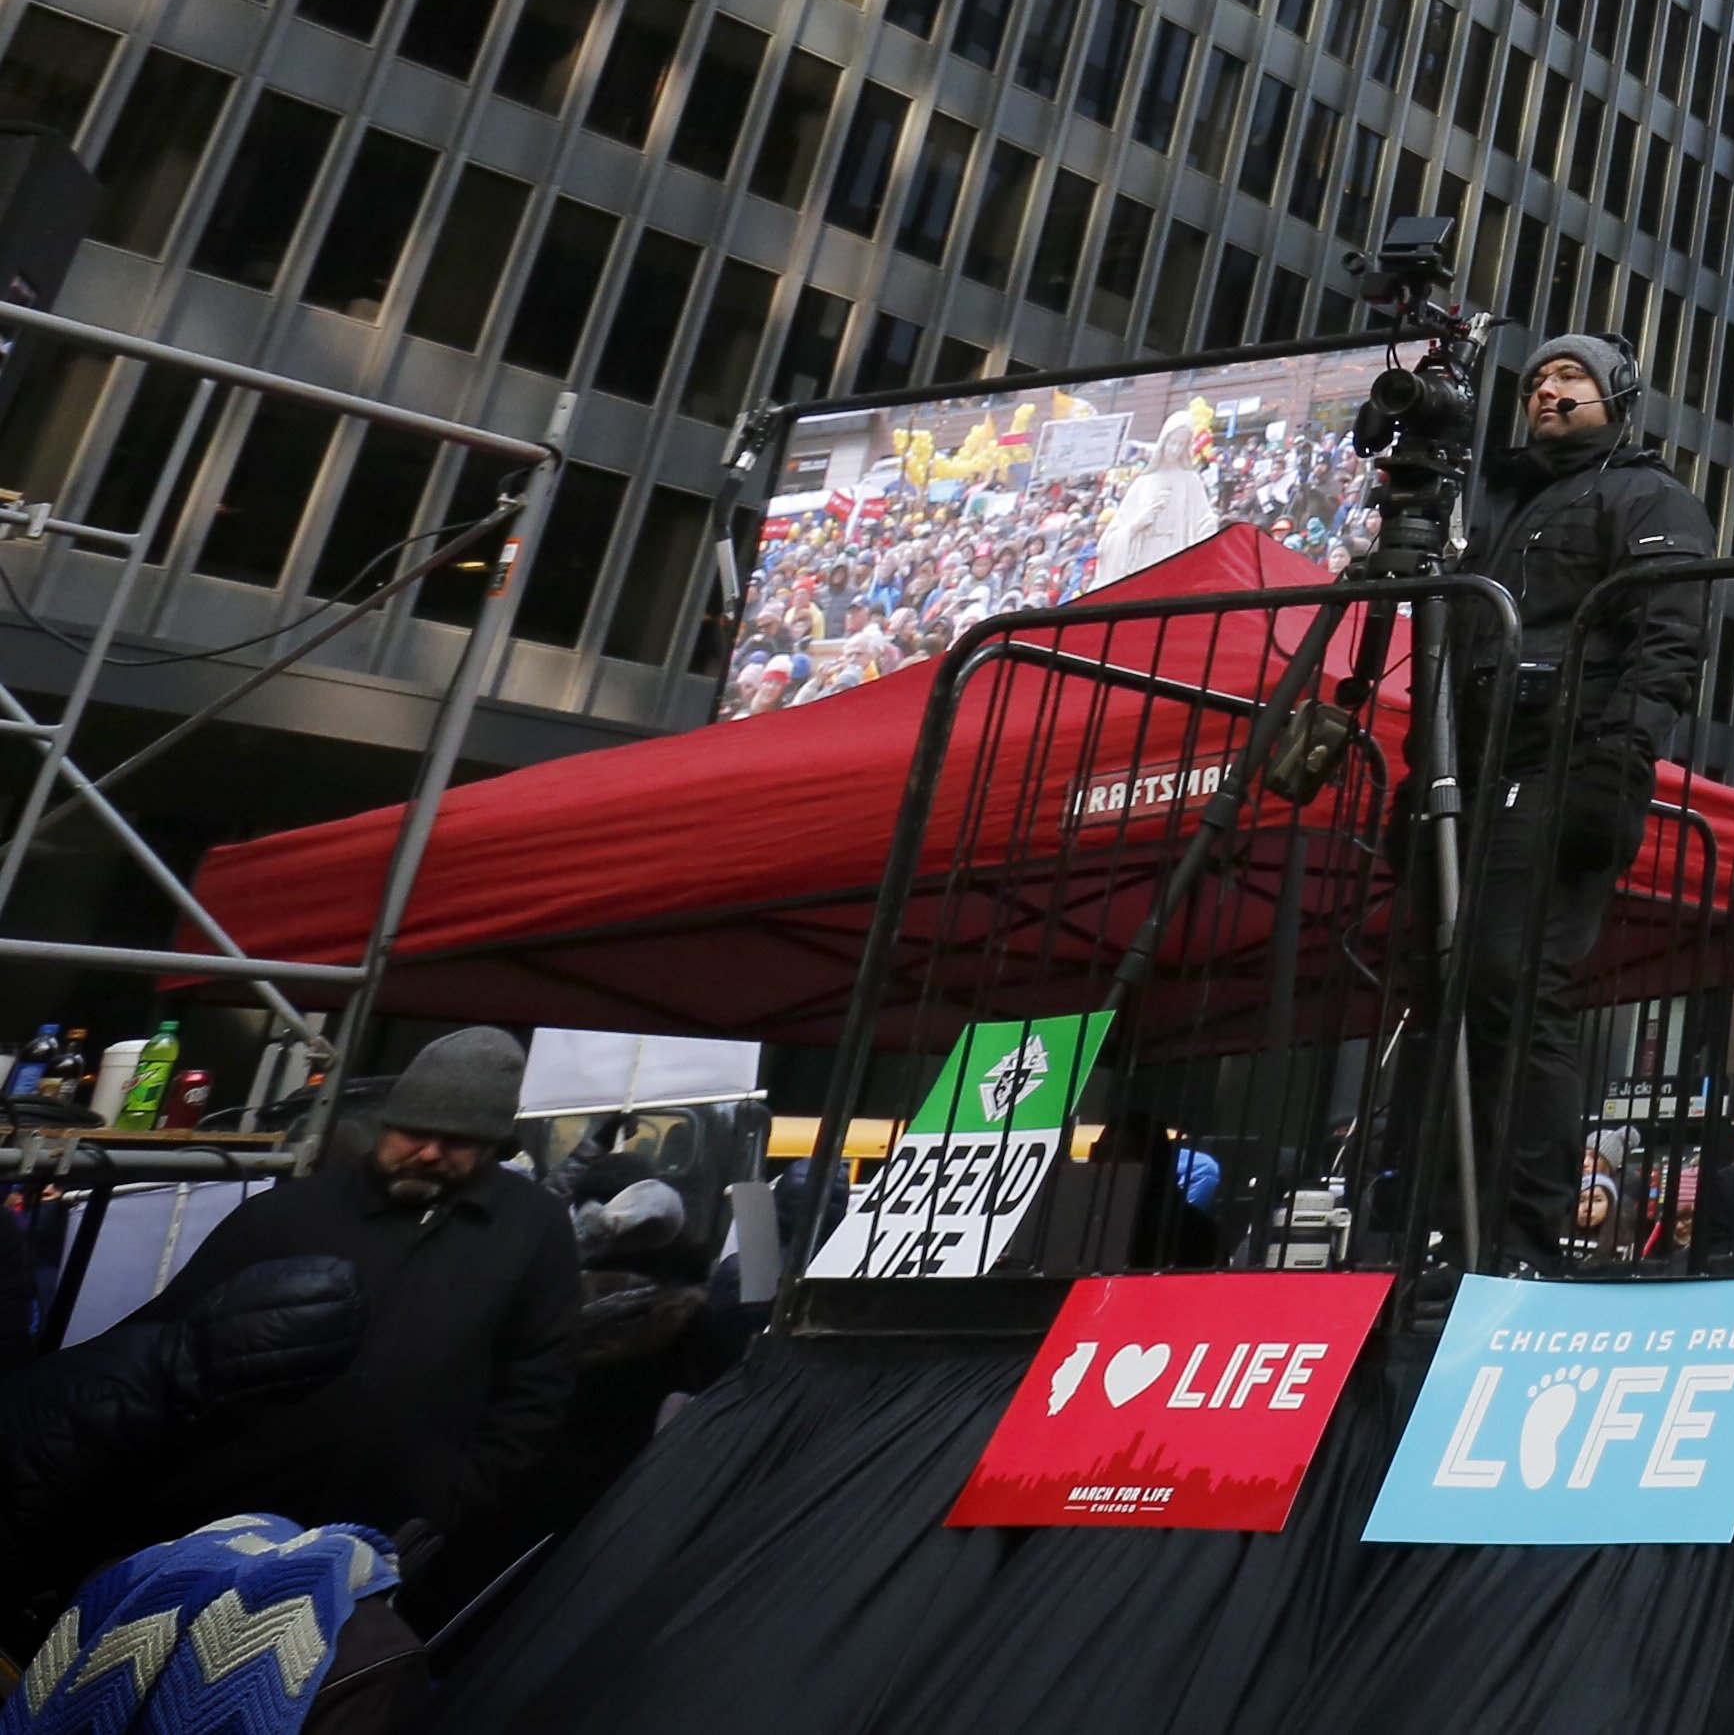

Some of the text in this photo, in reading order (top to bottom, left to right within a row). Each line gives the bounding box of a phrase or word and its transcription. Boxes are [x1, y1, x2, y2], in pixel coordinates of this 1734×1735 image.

[1073, 763, 1233, 817] RAFTSMA
[858, 1142, 1047, 1216] DEFEND
[1490, 1328, 1633, 1354] CHICAGO
[1644, 1326, 1674, 1352] IS
[1165, 1341, 1329, 1411] LIFE
[1068, 1486, 1175, 1503] MARCH FOR LIFE
[1089, 1503, 1137, 1513] CHICAGO
